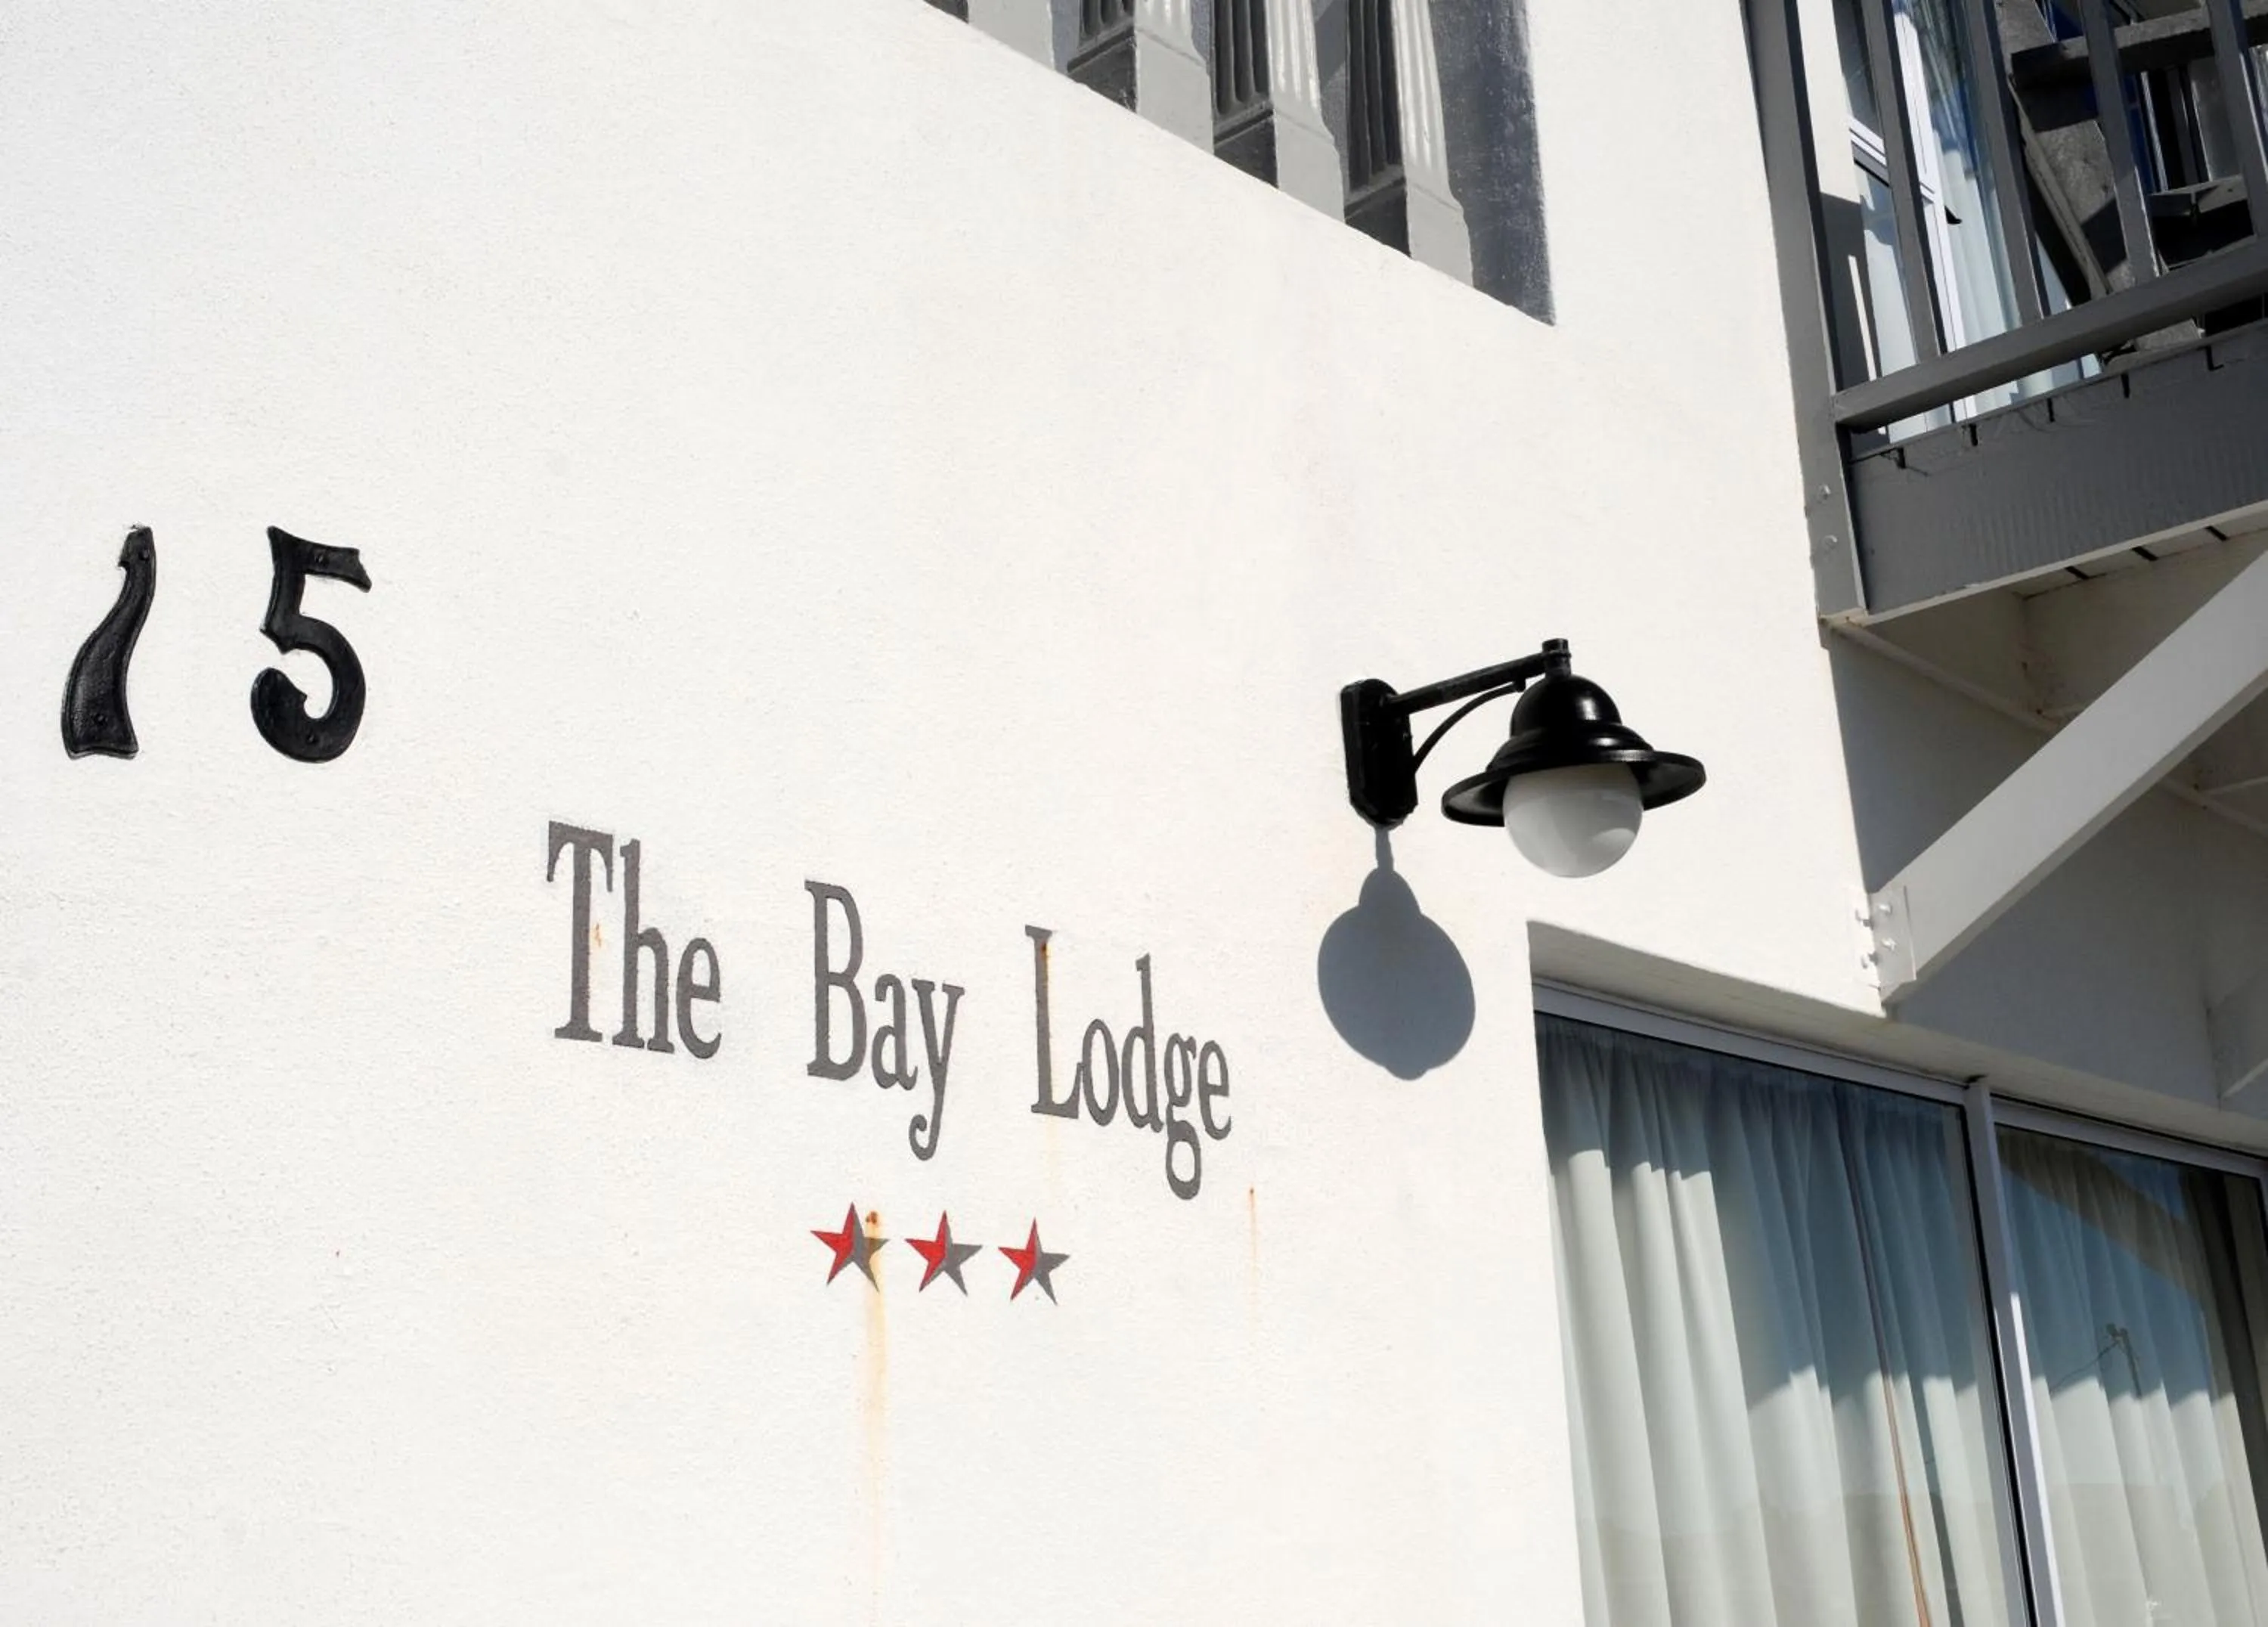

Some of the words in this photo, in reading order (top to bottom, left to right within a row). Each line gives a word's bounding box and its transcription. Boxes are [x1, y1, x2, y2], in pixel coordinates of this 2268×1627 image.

[60, 524, 373, 764] 15
[546, 820, 723, 1060] The
[804, 879, 965, 1161] Bay
[1024, 925, 1232, 1201] Lodge
